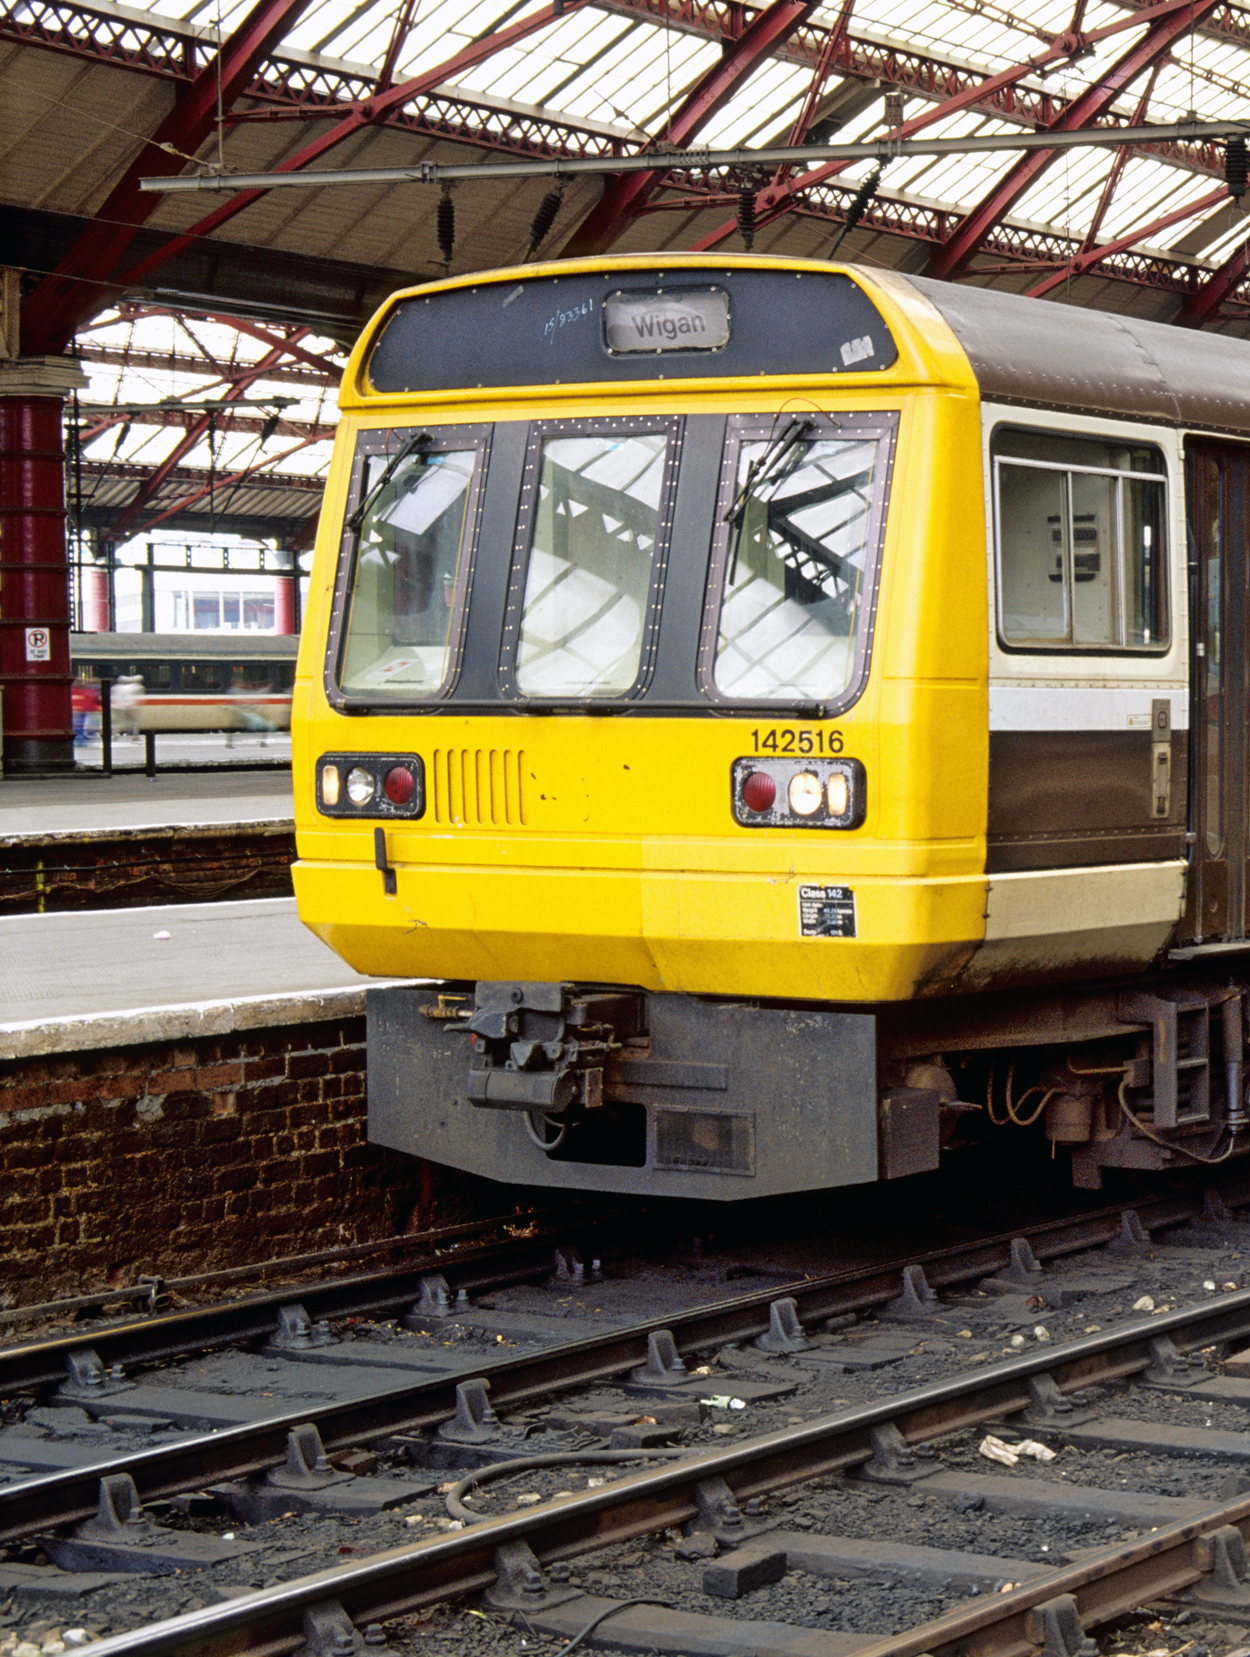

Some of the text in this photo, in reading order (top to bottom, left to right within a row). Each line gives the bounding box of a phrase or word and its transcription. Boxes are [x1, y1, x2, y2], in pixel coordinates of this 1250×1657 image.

[631, 314, 706, 341] Wigan
[750, 728, 845, 754] 142516
[800, 887, 843, 899] Class 142
